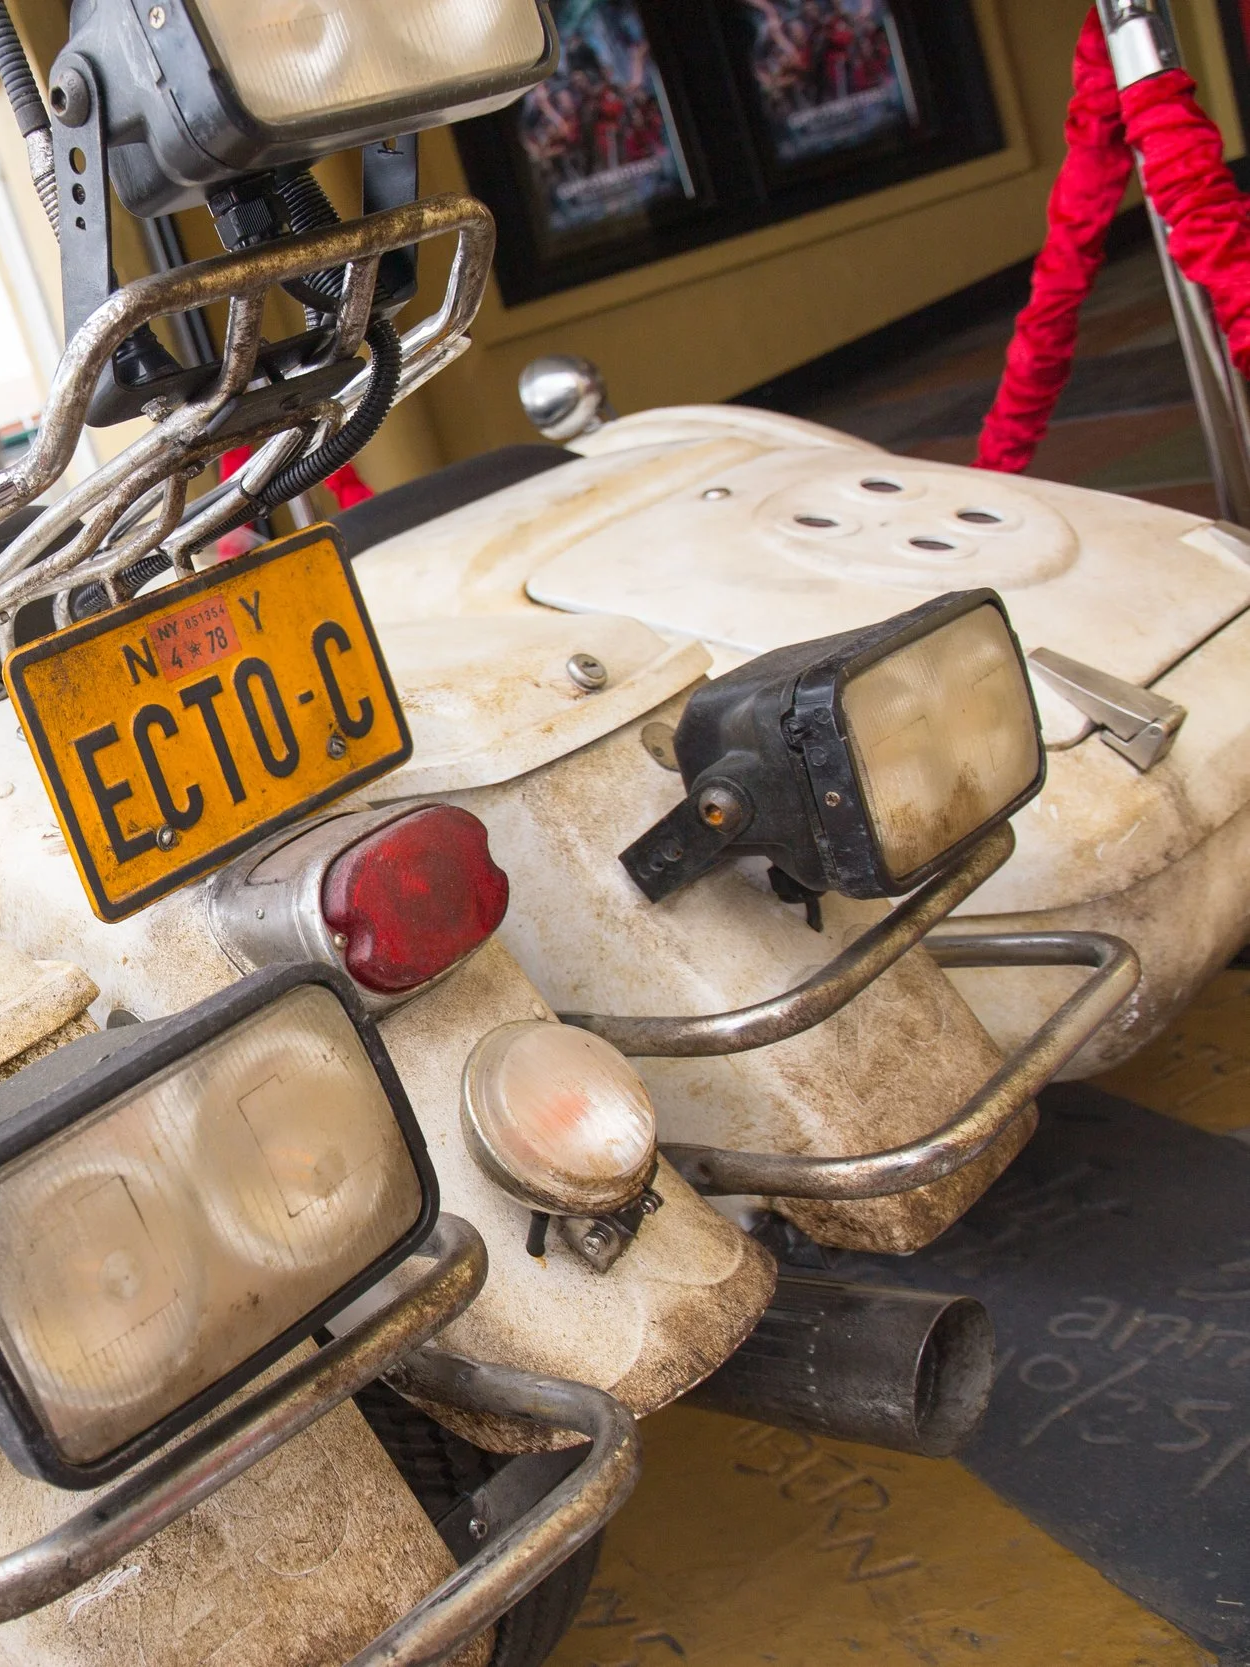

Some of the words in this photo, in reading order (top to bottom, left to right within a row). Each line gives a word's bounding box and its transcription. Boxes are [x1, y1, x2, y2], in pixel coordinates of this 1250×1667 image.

[122, 636, 158, 685] N
[238, 590, 262, 633] Y
[157, 621, 178, 641] NY
[171, 646, 183, 669] 4
[205, 626, 228, 654] 78
[73, 620, 374, 863] ECTO-C
